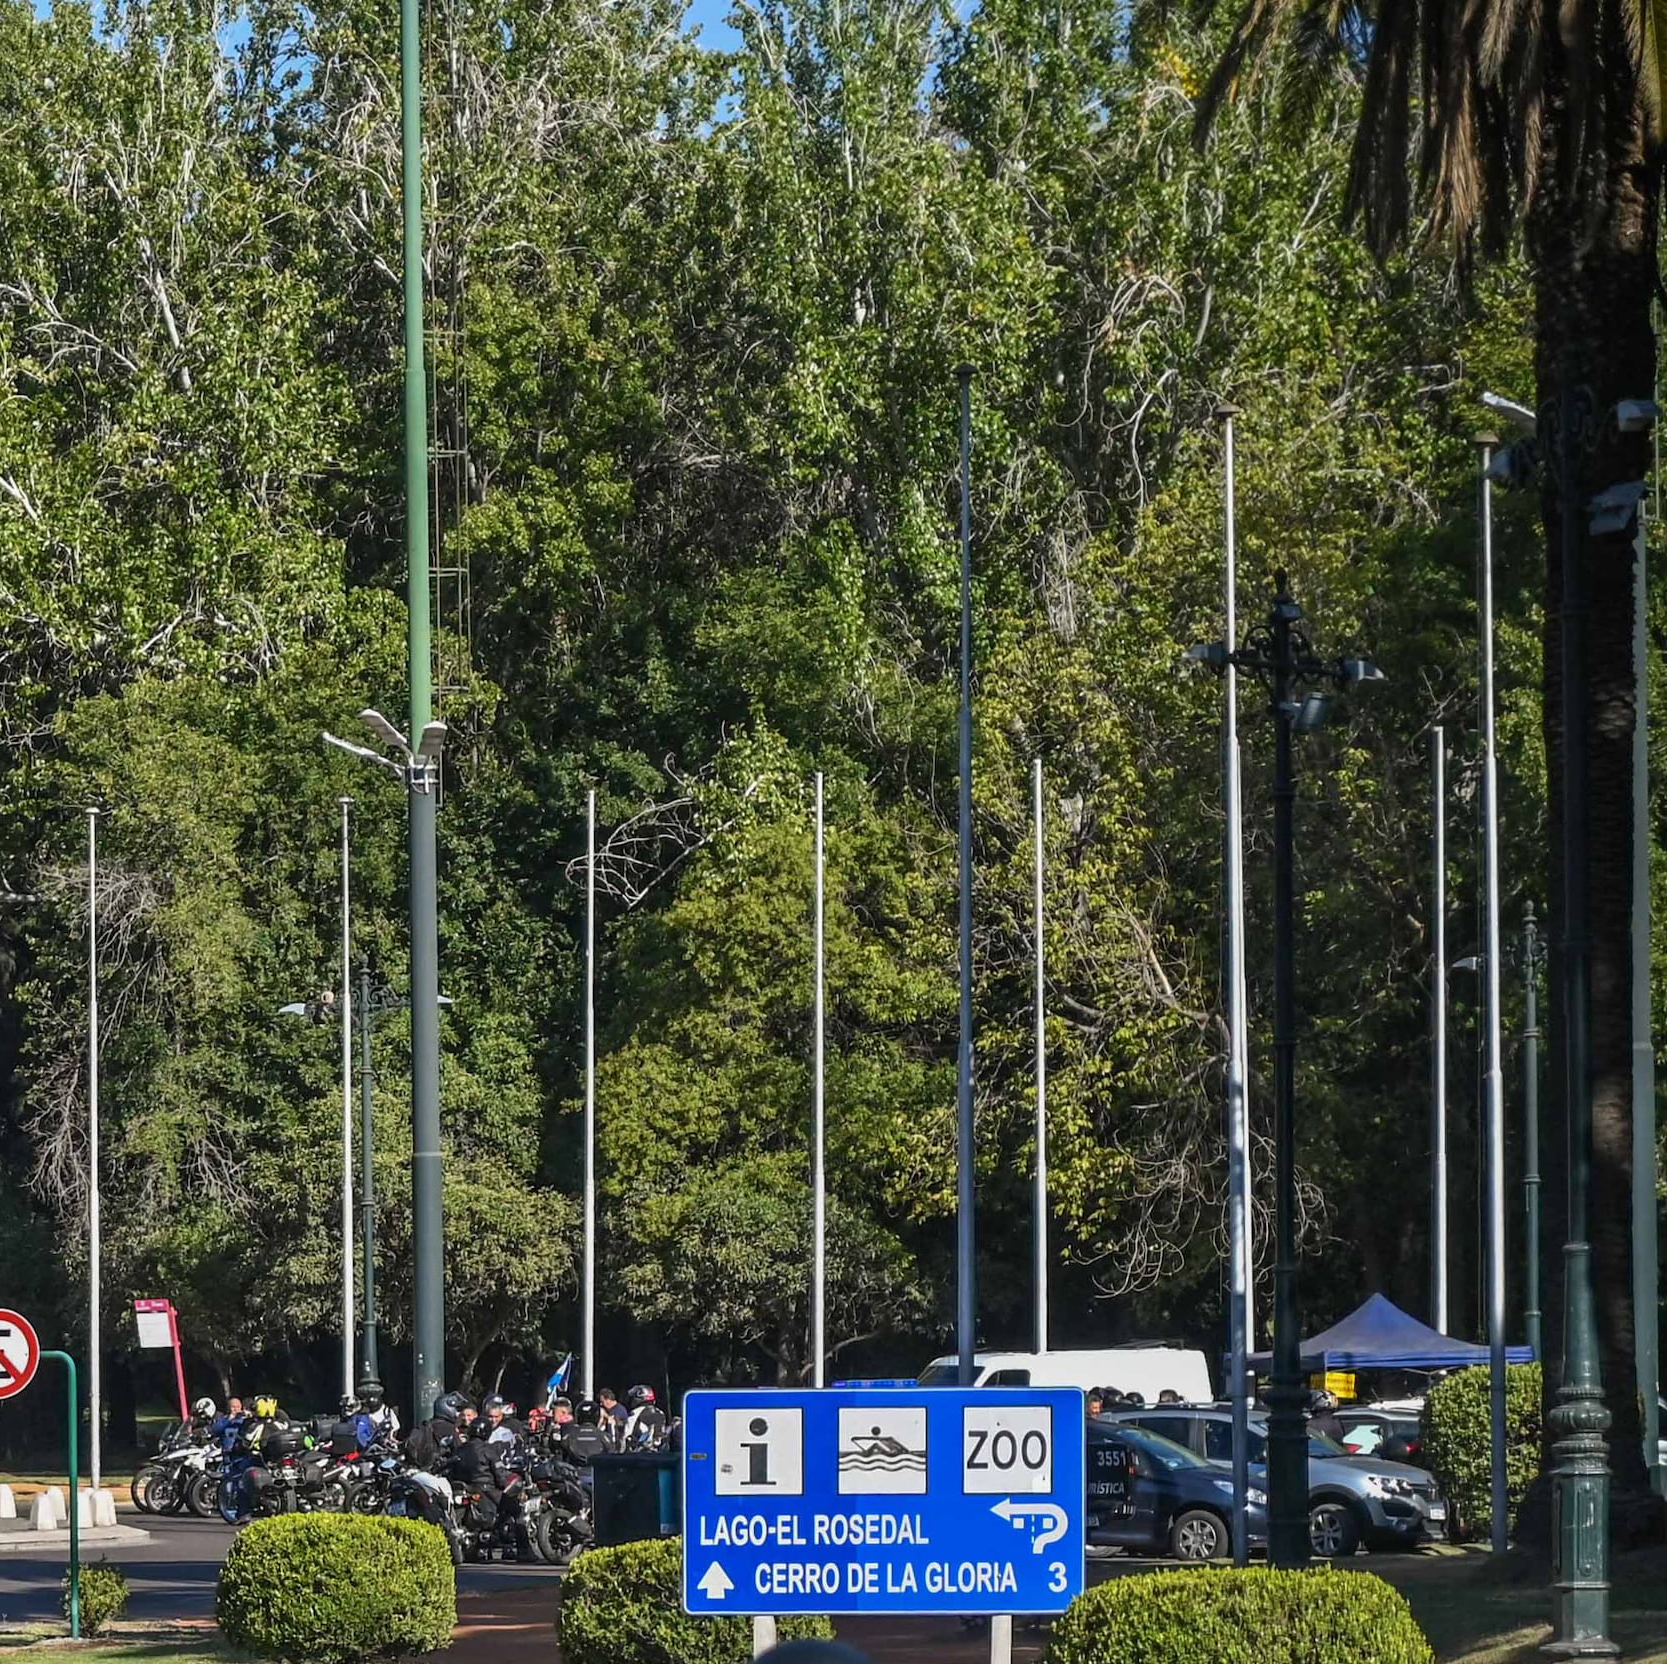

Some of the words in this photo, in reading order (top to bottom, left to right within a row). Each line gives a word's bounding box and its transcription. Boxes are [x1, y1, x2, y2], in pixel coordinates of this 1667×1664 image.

[967, 1430, 1047, 1470] ZOO
[1097, 1451, 1127, 1467] 3551
[700, 1515, 807, 1546] LAGO-EL
[814, 1514, 930, 1545] ROSEDAL
[755, 1562, 840, 1594] CERRO
[847, 1562, 880, 1594] DE
[887, 1562, 919, 1594] LA
[924, 1561, 1018, 1594] GLORIA
[1048, 1562, 1068, 1593] 3
